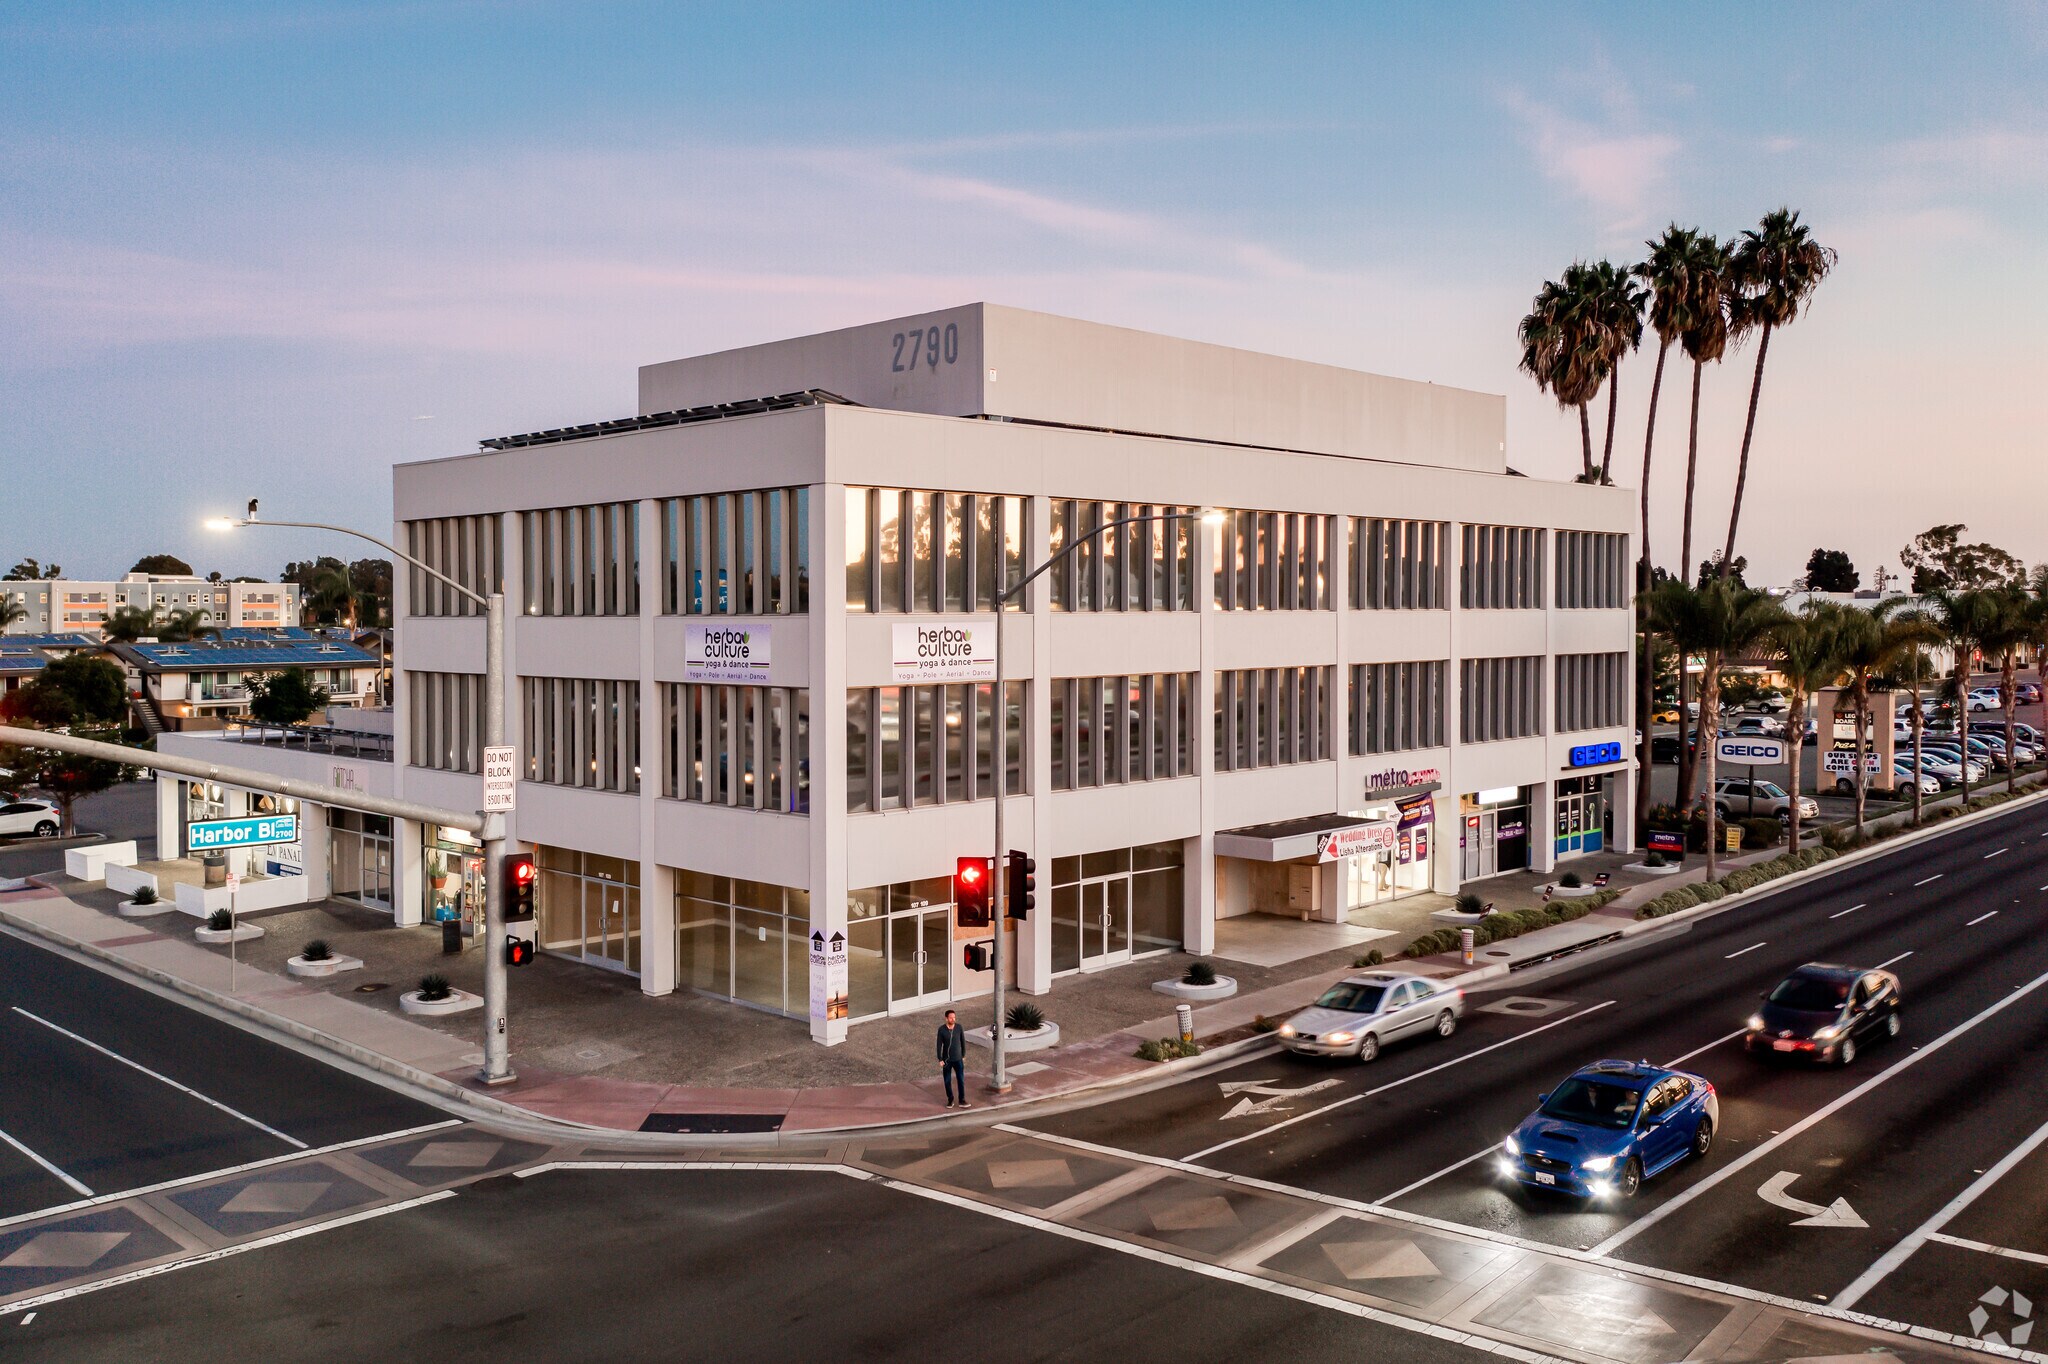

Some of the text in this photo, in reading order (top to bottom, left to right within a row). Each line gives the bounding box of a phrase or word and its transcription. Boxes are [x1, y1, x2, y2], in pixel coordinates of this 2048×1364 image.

[892, 322, 958, 373] 2790
[705, 627, 742, 644] herba
[918, 626, 962, 643] herba
[704, 642, 750, 658] culture
[917, 641, 972, 657] culture
[705, 660, 749, 669] yoga & dance
[919, 658, 972, 669] yoga & dance
[946, 670, 964, 678] Aerial
[972, 669, 992, 677] Dance
[487, 752, 512, 763] DO NOT
[1570, 741, 1622, 767] GEICO
[1721, 744, 1779, 758] GEICO
[488, 767, 512, 777] BLOCK
[1371, 767, 1408, 787] metro
[502, 793, 512, 804] FINE
[191, 821, 275, 845] Harbor Bl
[275, 829, 293, 839] 2700
[1340, 830, 1366, 843] Wedding
[1366, 828, 1383, 839] Dress
[1655, 834, 1676, 842] metro
[1340, 843, 1383, 857] Lisha Alterations
